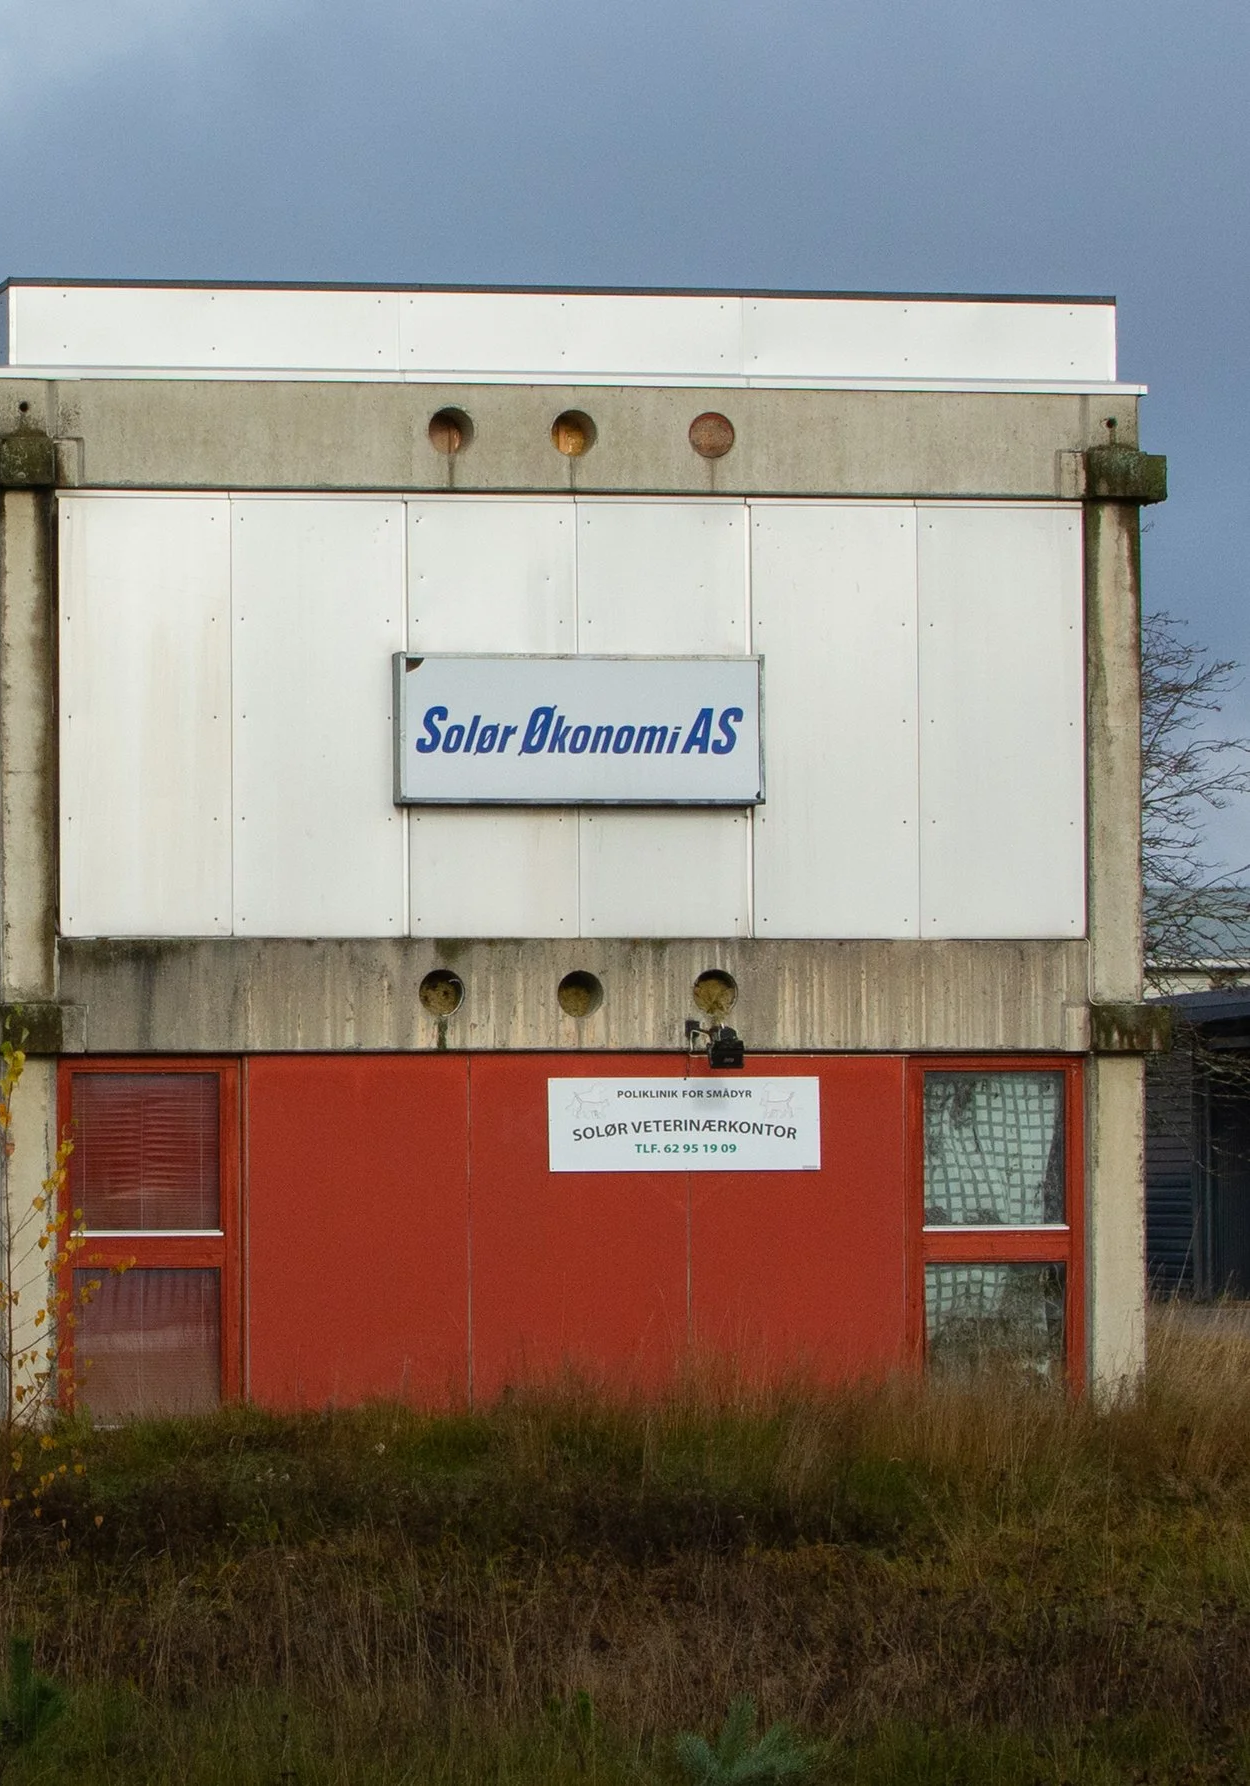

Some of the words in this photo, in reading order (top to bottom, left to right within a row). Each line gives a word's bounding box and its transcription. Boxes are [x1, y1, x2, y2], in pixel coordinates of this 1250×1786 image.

[416, 705, 519, 756] Solør
[518, 704, 683, 757] Økonomi
[681, 706, 744, 755] AS
[617, 1090, 678, 1099] POLIKLINIK
[682, 1089, 704, 1098] FOR
[706, 1087, 752, 1099] SMÅDYR
[572, 1122, 628, 1142] SOLØR
[631, 1119, 798, 1141] VETERINÆRKONTOR
[634, 1143, 660, 1154] TLF.
[663, 1143, 680, 1154] 62
[682, 1143, 699, 1154] 95
[702, 1143, 718, 1154] 19
[720, 1143, 737, 1153] 09
